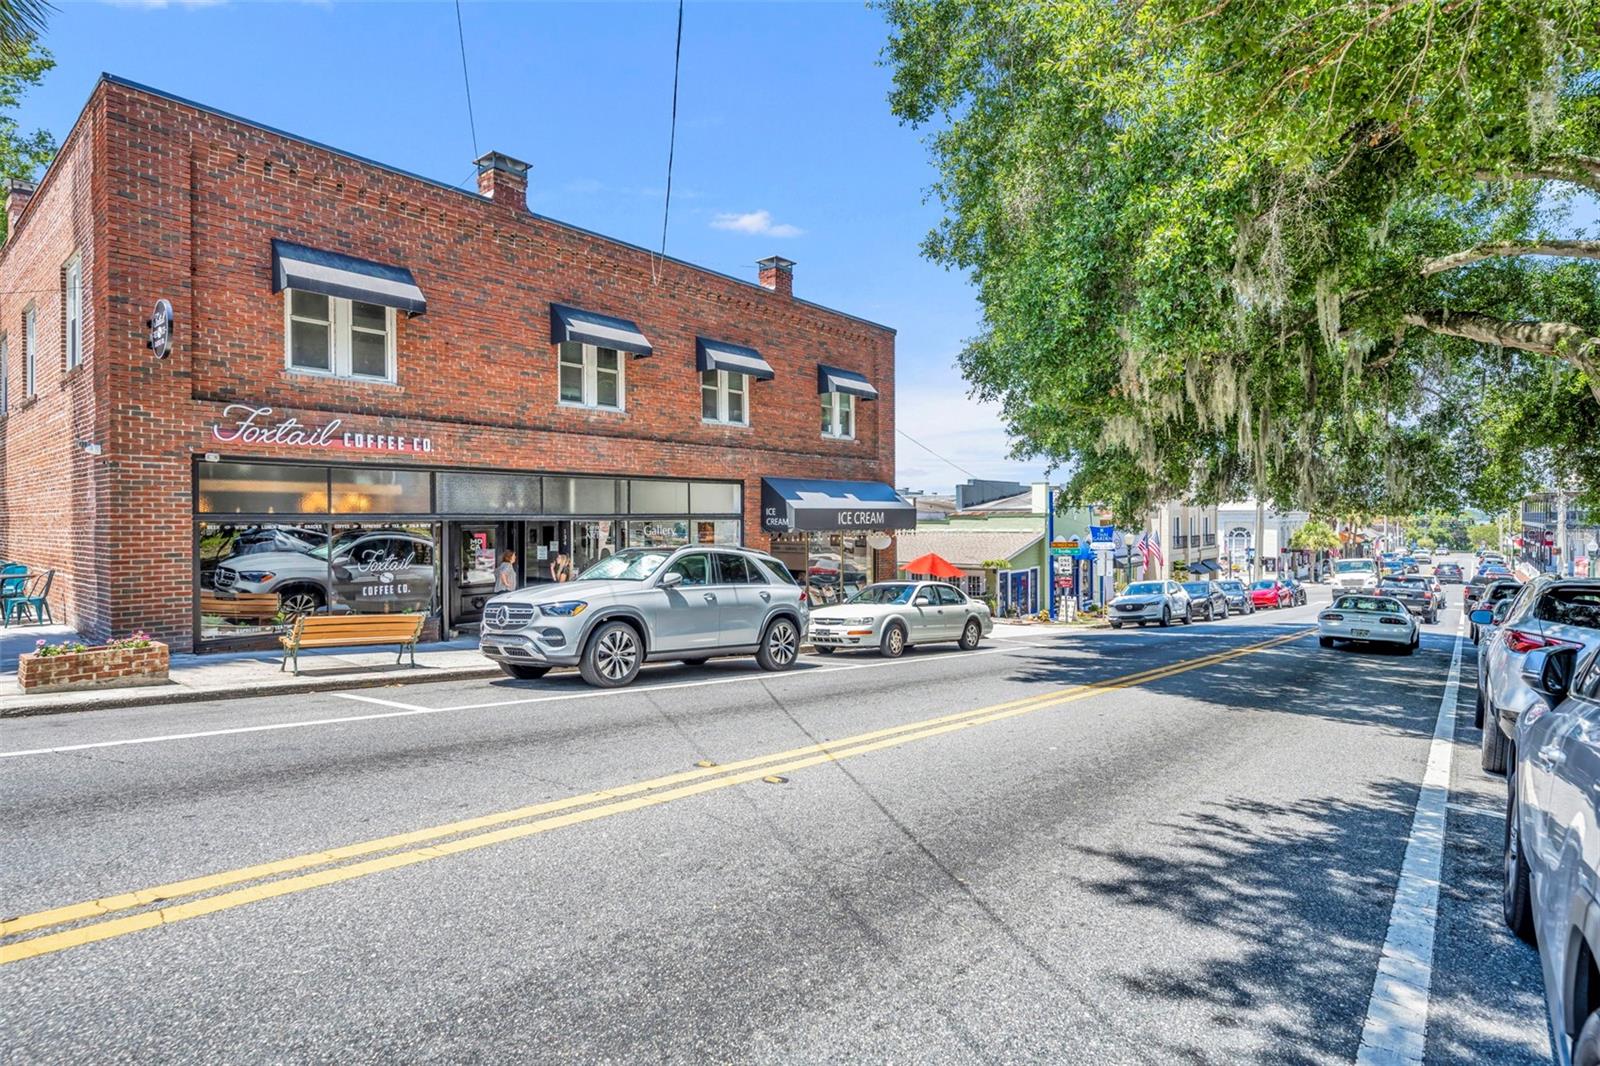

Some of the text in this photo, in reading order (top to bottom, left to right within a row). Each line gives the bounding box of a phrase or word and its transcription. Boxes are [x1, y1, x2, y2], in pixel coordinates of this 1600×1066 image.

[213, 404, 435, 453] Foxtail COFFEE CO.
[765, 508, 776, 516] ICE
[766, 518, 789, 526] CREAM
[838, 512, 885, 525] ICE CREAM
[643, 525, 677, 537] Gallery
[357, 549, 416, 572] Foxtail
[362, 584, 411, 596] COFFEE CO.
